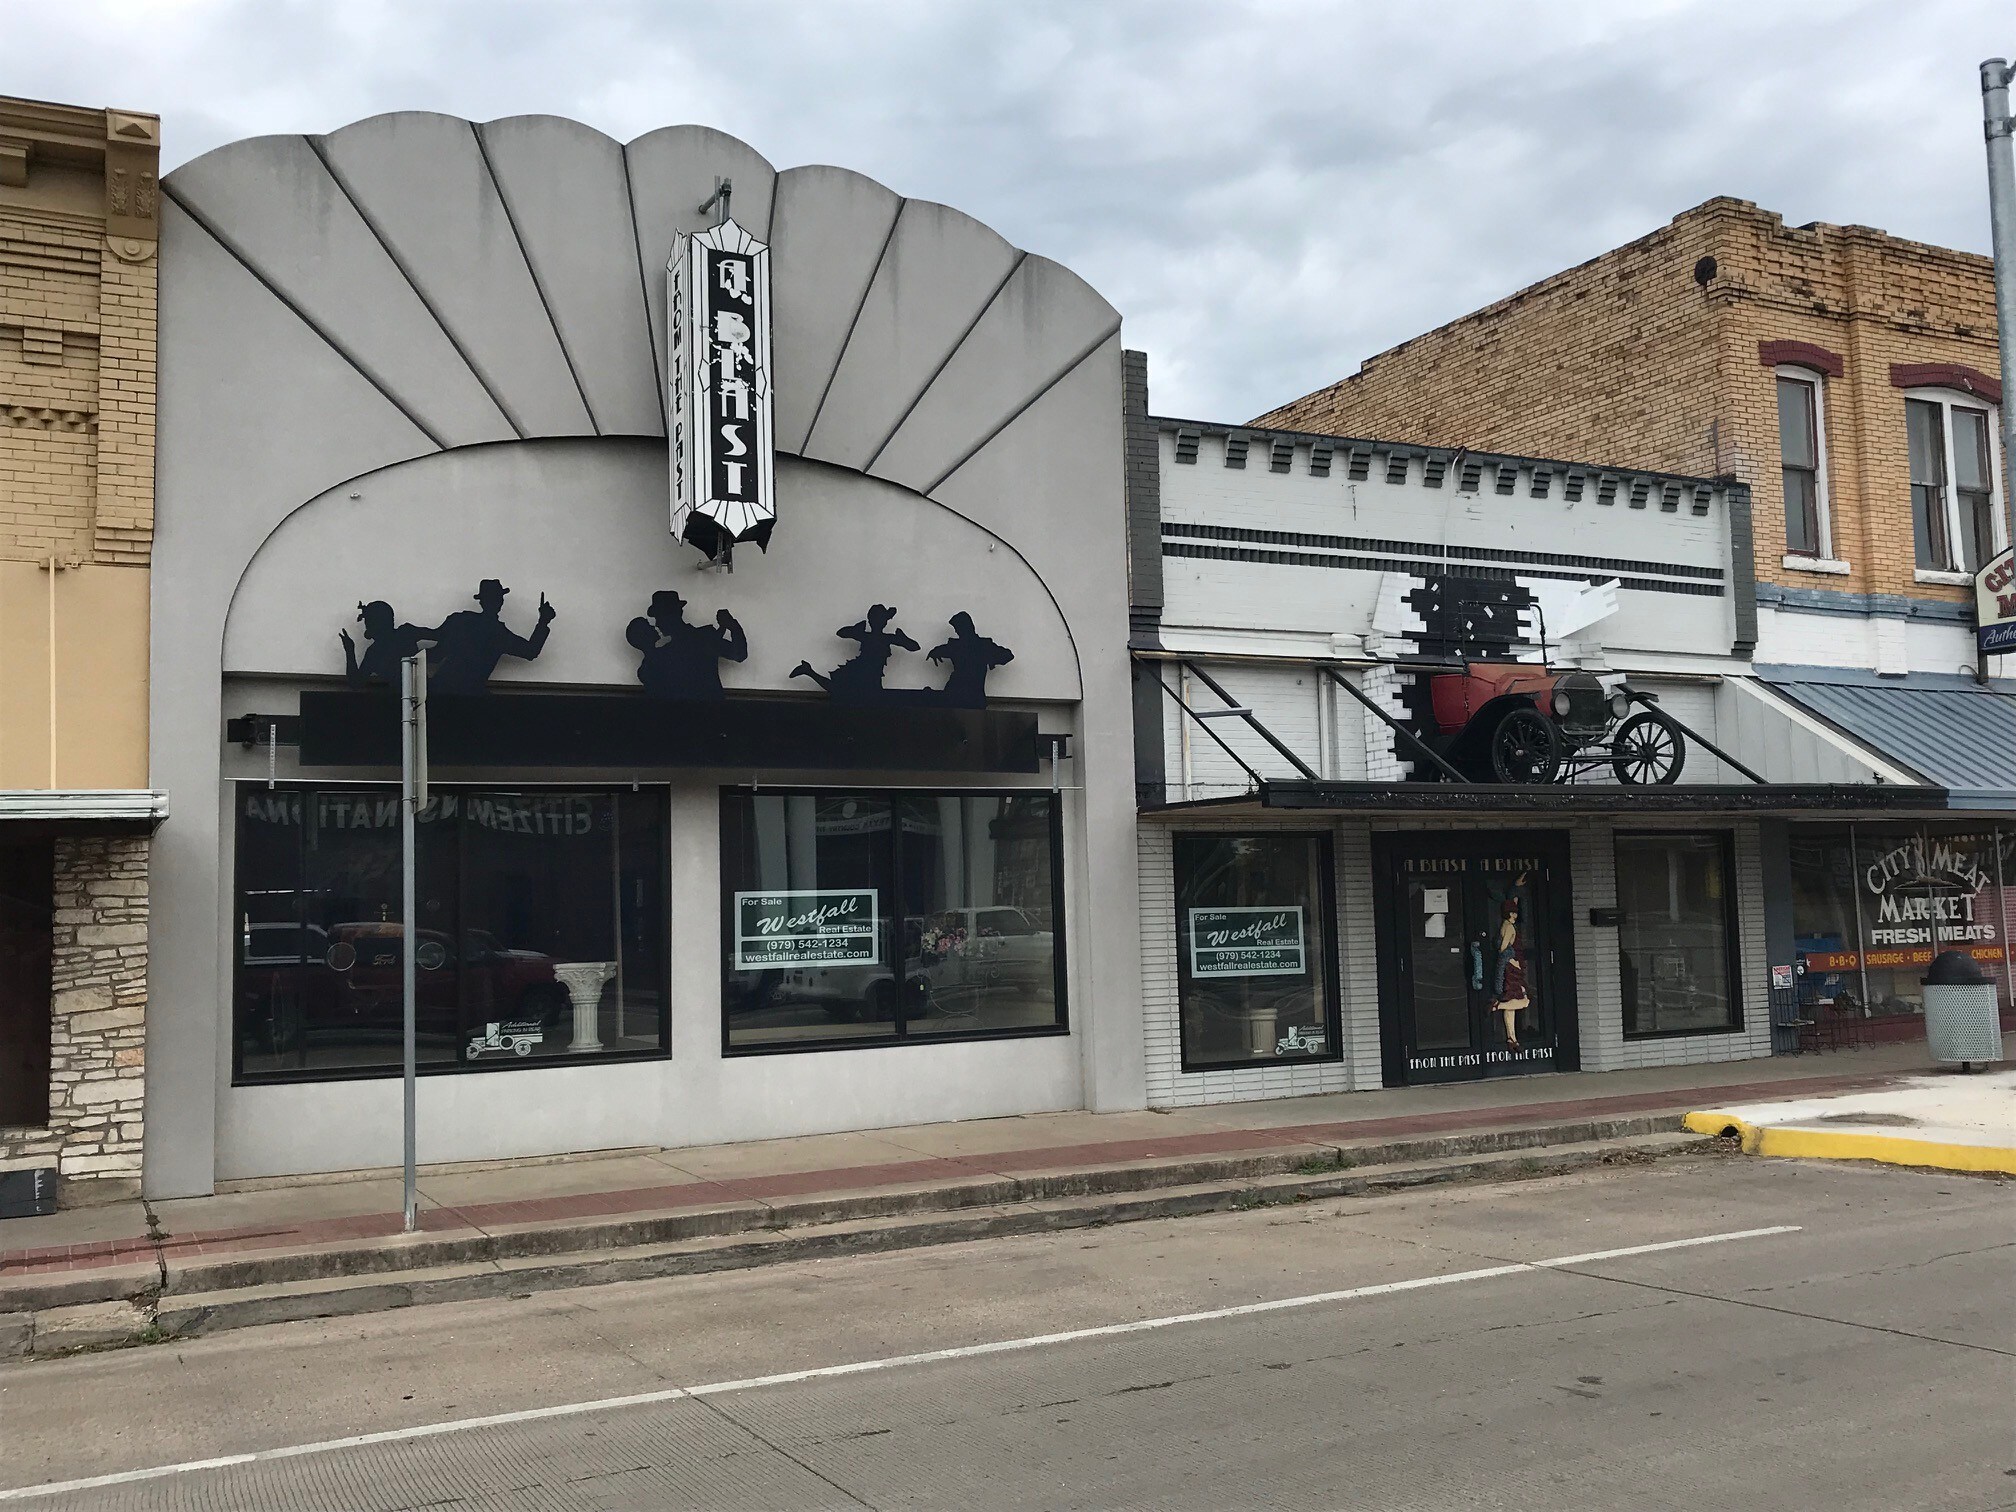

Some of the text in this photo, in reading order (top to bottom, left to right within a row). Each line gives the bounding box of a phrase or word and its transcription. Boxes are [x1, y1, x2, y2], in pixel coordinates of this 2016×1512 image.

[716, 259, 751, 495] A BLAST
[673, 270, 684, 501] FROM THE PAST
[1403, 858, 1468, 872] A BLAST
[1480, 857, 1540, 871] A BLAST
[1866, 841, 1991, 895] CITY MEAT
[742, 897, 783, 906] For Sale
[1877, 892, 1977, 923] MARKET
[756, 896, 858, 935] Westfall
[1209, 913, 1227, 921] Sale
[819, 924, 872, 934] Real Estate
[1206, 912, 1287, 947] Westfall
[1871, 924, 1996, 945] FRESH MEATS
[766, 938, 849, 952] (979) 542-1234
[1275, 938, 1299, 946] Estate
[745, 950, 870, 963] westfallrealestate.com
[1216, 950, 1281, 961] (979) 542-1234
[1866, 952, 1904, 965] SAUSAGE
[1912, 951, 1932, 962] BEEF
[1971, 947, 2003, 960] CHICKEN
[1199, 960, 1299, 971] westfallrealestate.com
[1532, 1047, 1553, 1059] PAST
[1439, 1055, 1456, 1068] THE
[1458, 1053, 1480, 1066] PAST
